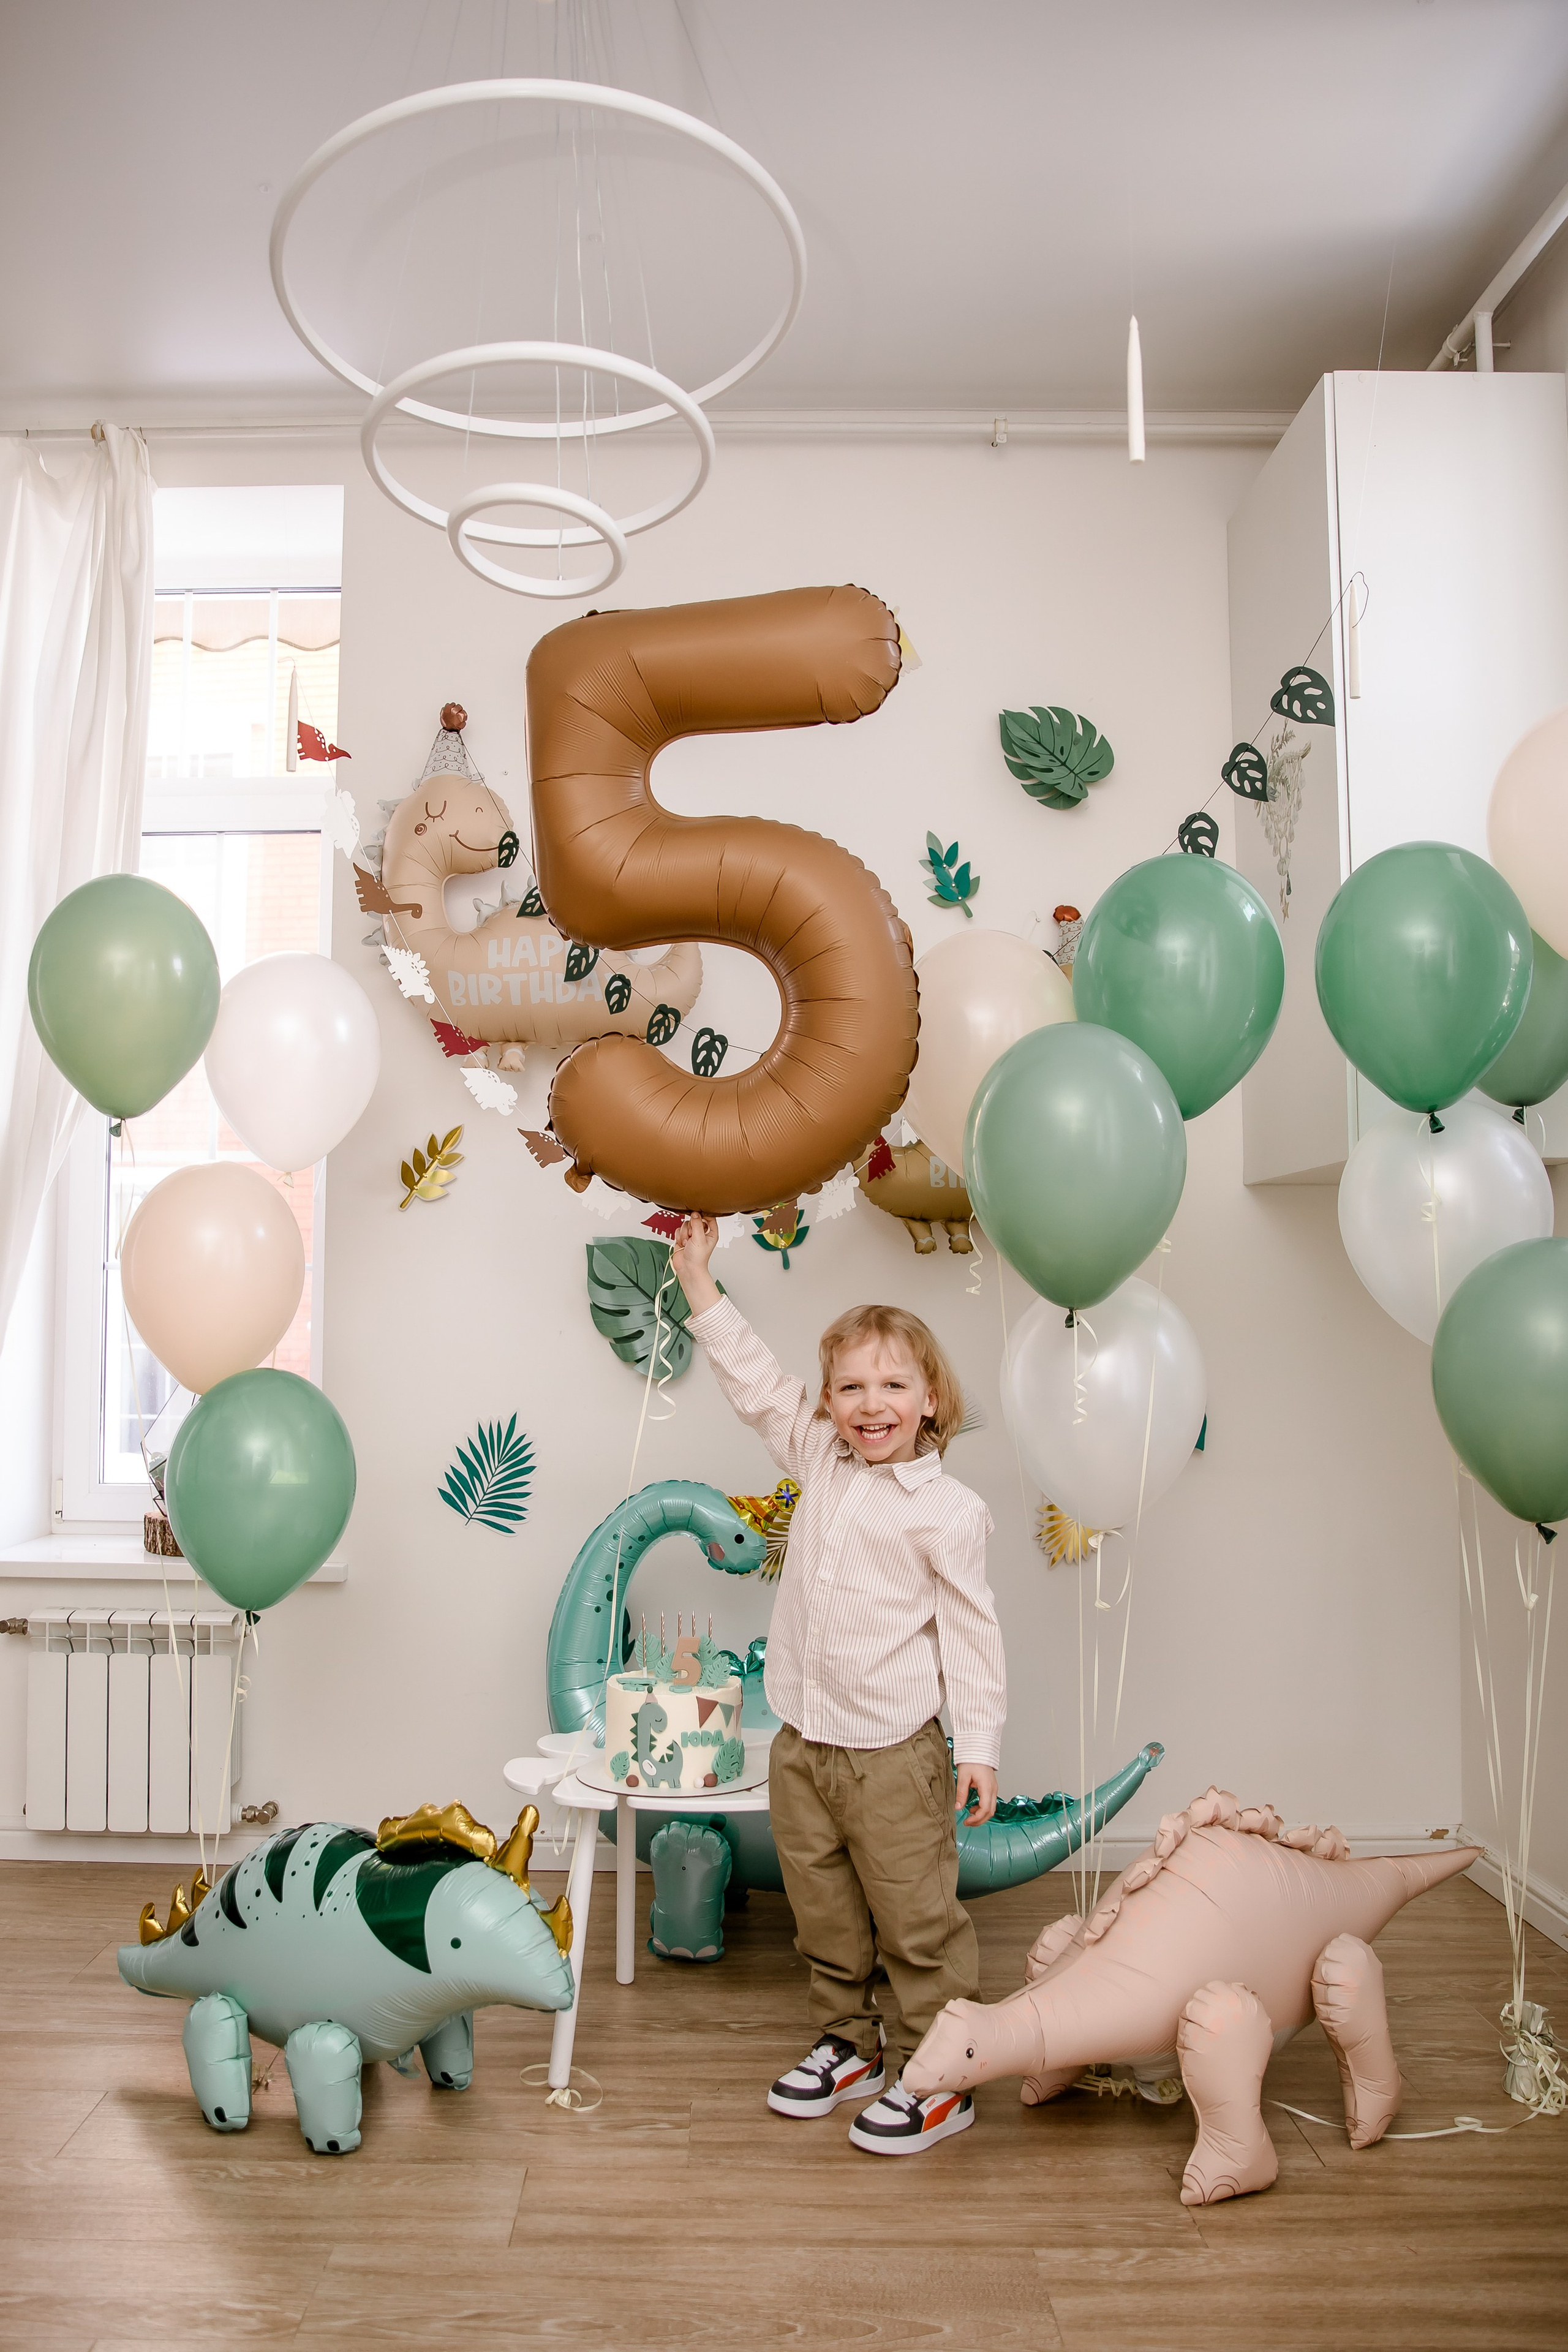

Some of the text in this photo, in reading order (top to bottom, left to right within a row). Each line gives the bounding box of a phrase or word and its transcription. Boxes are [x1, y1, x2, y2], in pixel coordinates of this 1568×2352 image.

[525, 584, 919, 1217] 5
[488, 934, 605, 968] HAP
[671, 1637, 702, 1686] 5
